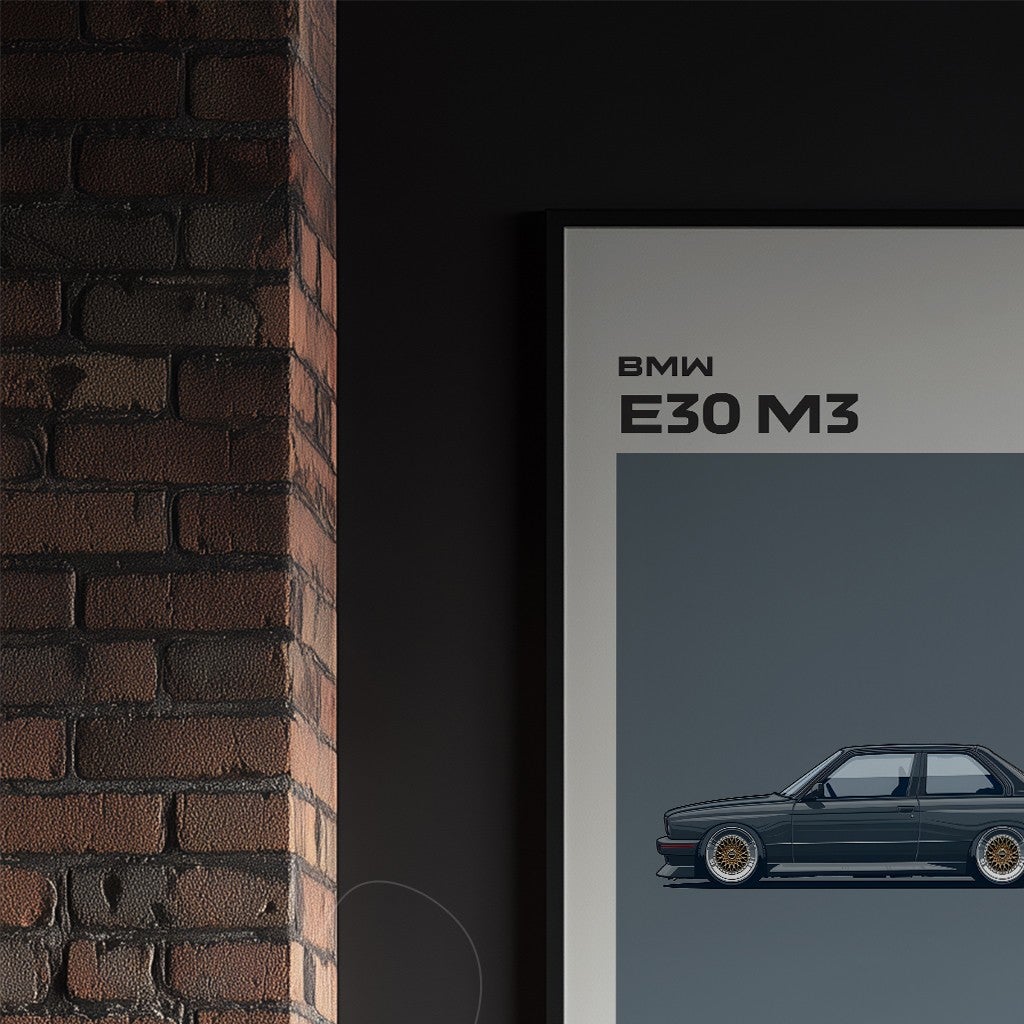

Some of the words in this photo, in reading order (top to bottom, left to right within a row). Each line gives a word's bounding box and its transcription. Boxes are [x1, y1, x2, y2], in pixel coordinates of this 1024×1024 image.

[618, 356, 713, 377] BMW
[620, 392, 741, 435] E30
[758, 393, 859, 435] M3
